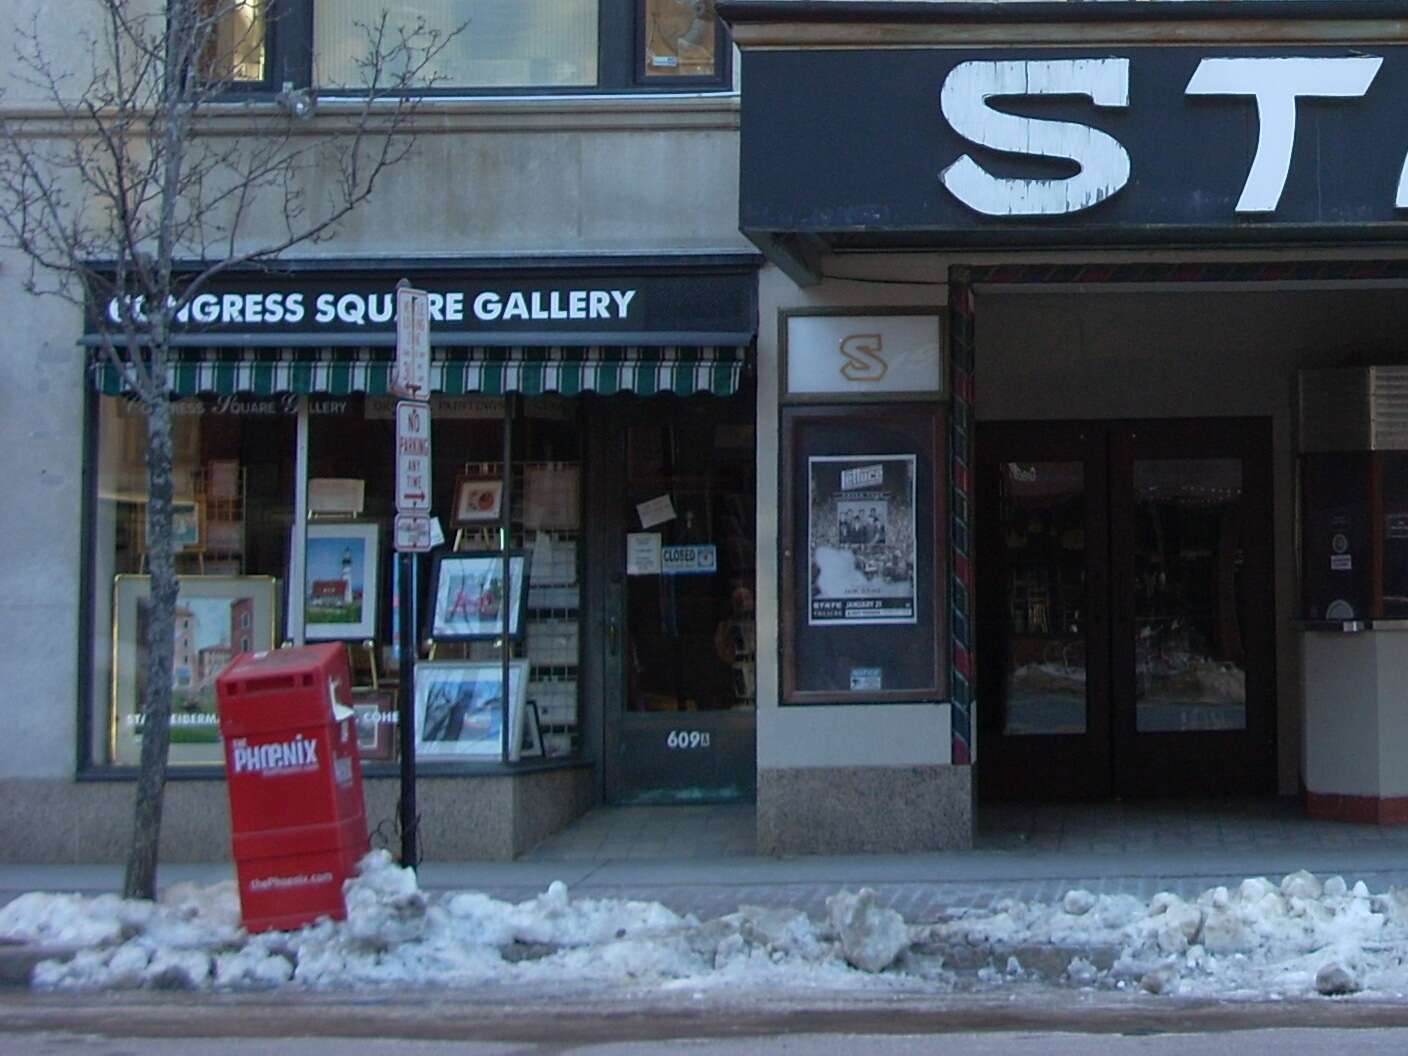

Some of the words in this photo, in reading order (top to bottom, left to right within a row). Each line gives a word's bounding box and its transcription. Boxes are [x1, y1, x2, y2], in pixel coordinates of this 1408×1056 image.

[315, 293, 464, 325] SQURE
[473, 290, 636, 322] GALLERY
[840, 334, 888, 381] S
[125, 397, 205, 414] CORESS
[212, 395, 277, 414] SQUARE
[282, 394, 347, 414] GLLERY
[408, 414, 420, 433] NO
[400, 437, 430, 457] PARKING
[408, 460, 421, 473] ANY
[406, 476, 422, 490] TIME
[663, 549, 696, 562] CLOSED
[363, 712, 400, 724] COHE
